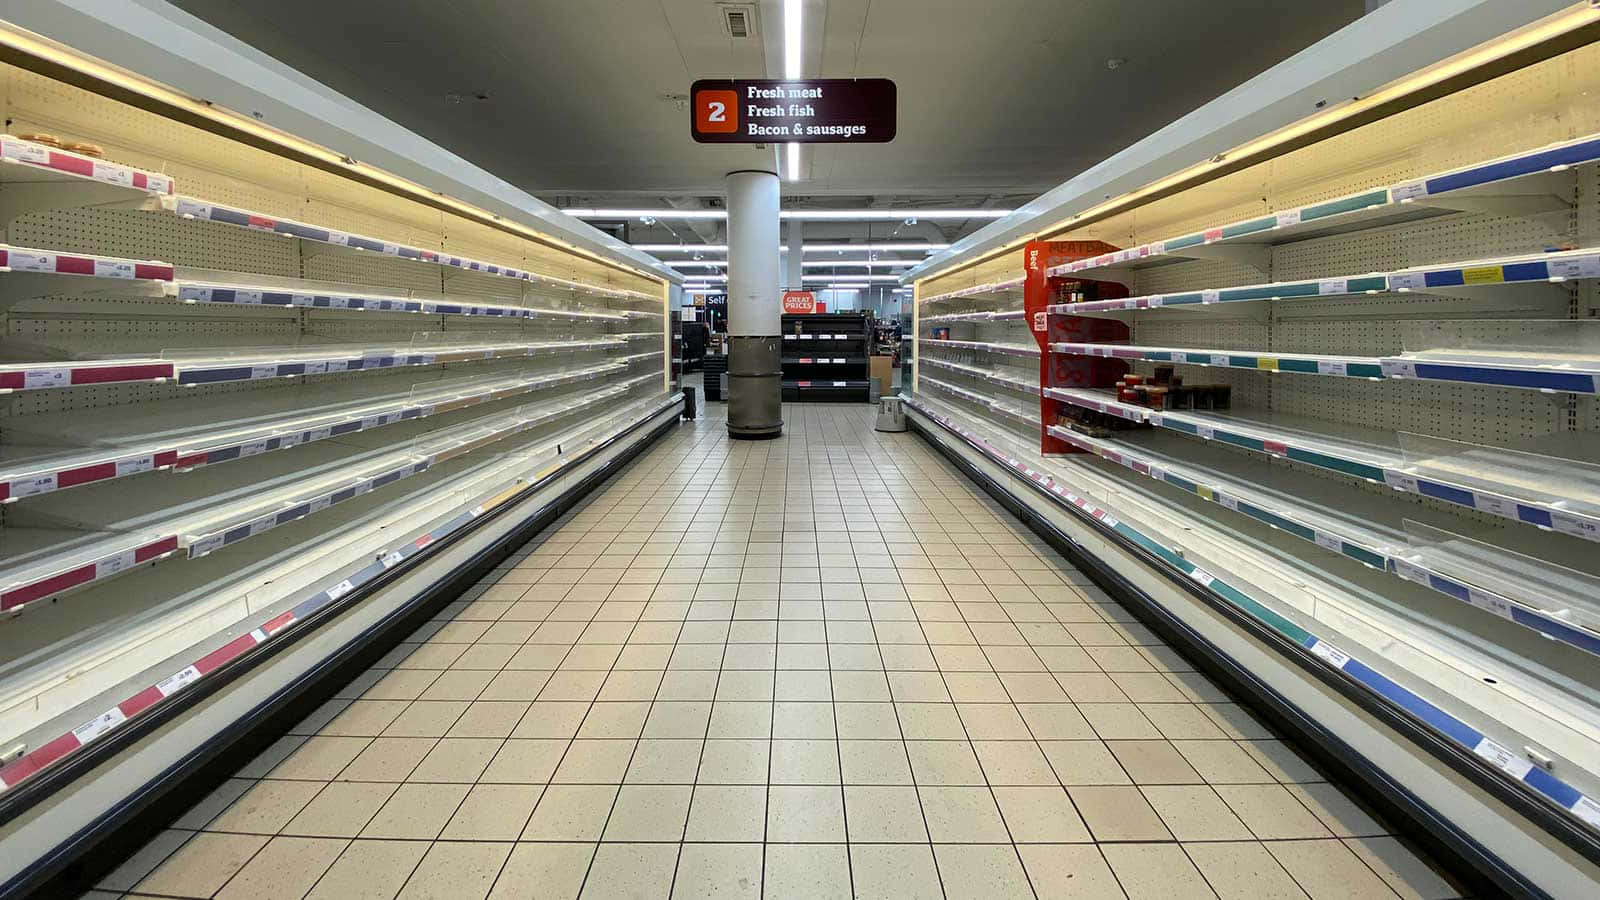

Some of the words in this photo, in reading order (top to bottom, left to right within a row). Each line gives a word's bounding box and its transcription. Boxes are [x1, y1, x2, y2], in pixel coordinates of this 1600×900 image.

[747, 86, 785, 99] Fresh
[788, 87, 823, 99] meat
[708, 101, 726, 122] 2
[747, 105, 785, 117] Fresh
[788, 105, 815, 117] fish
[748, 123, 789, 136] Bacon
[792, 123, 803, 136] &
[806, 125, 867, 138] sausages
[1030, 250, 1039, 271] Beef
[708, 295, 726, 305] Self
